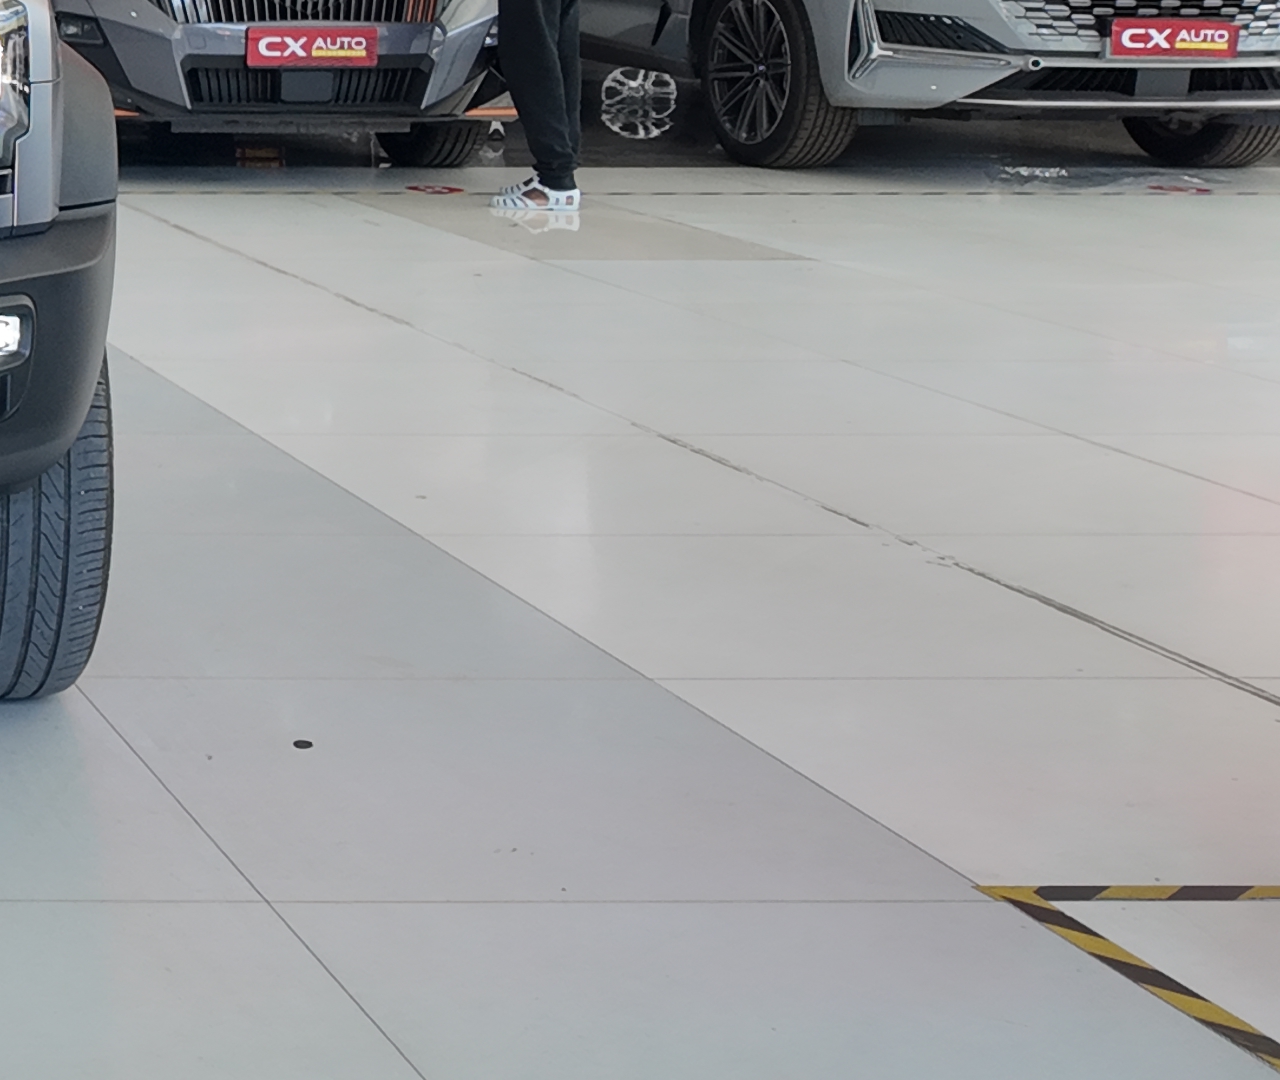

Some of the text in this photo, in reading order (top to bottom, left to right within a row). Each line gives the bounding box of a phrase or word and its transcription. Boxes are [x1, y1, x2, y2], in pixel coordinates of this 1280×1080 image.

[258, 36, 366, 57] CX AUTO
[1121, 28, 1229, 48] CX AUTO
